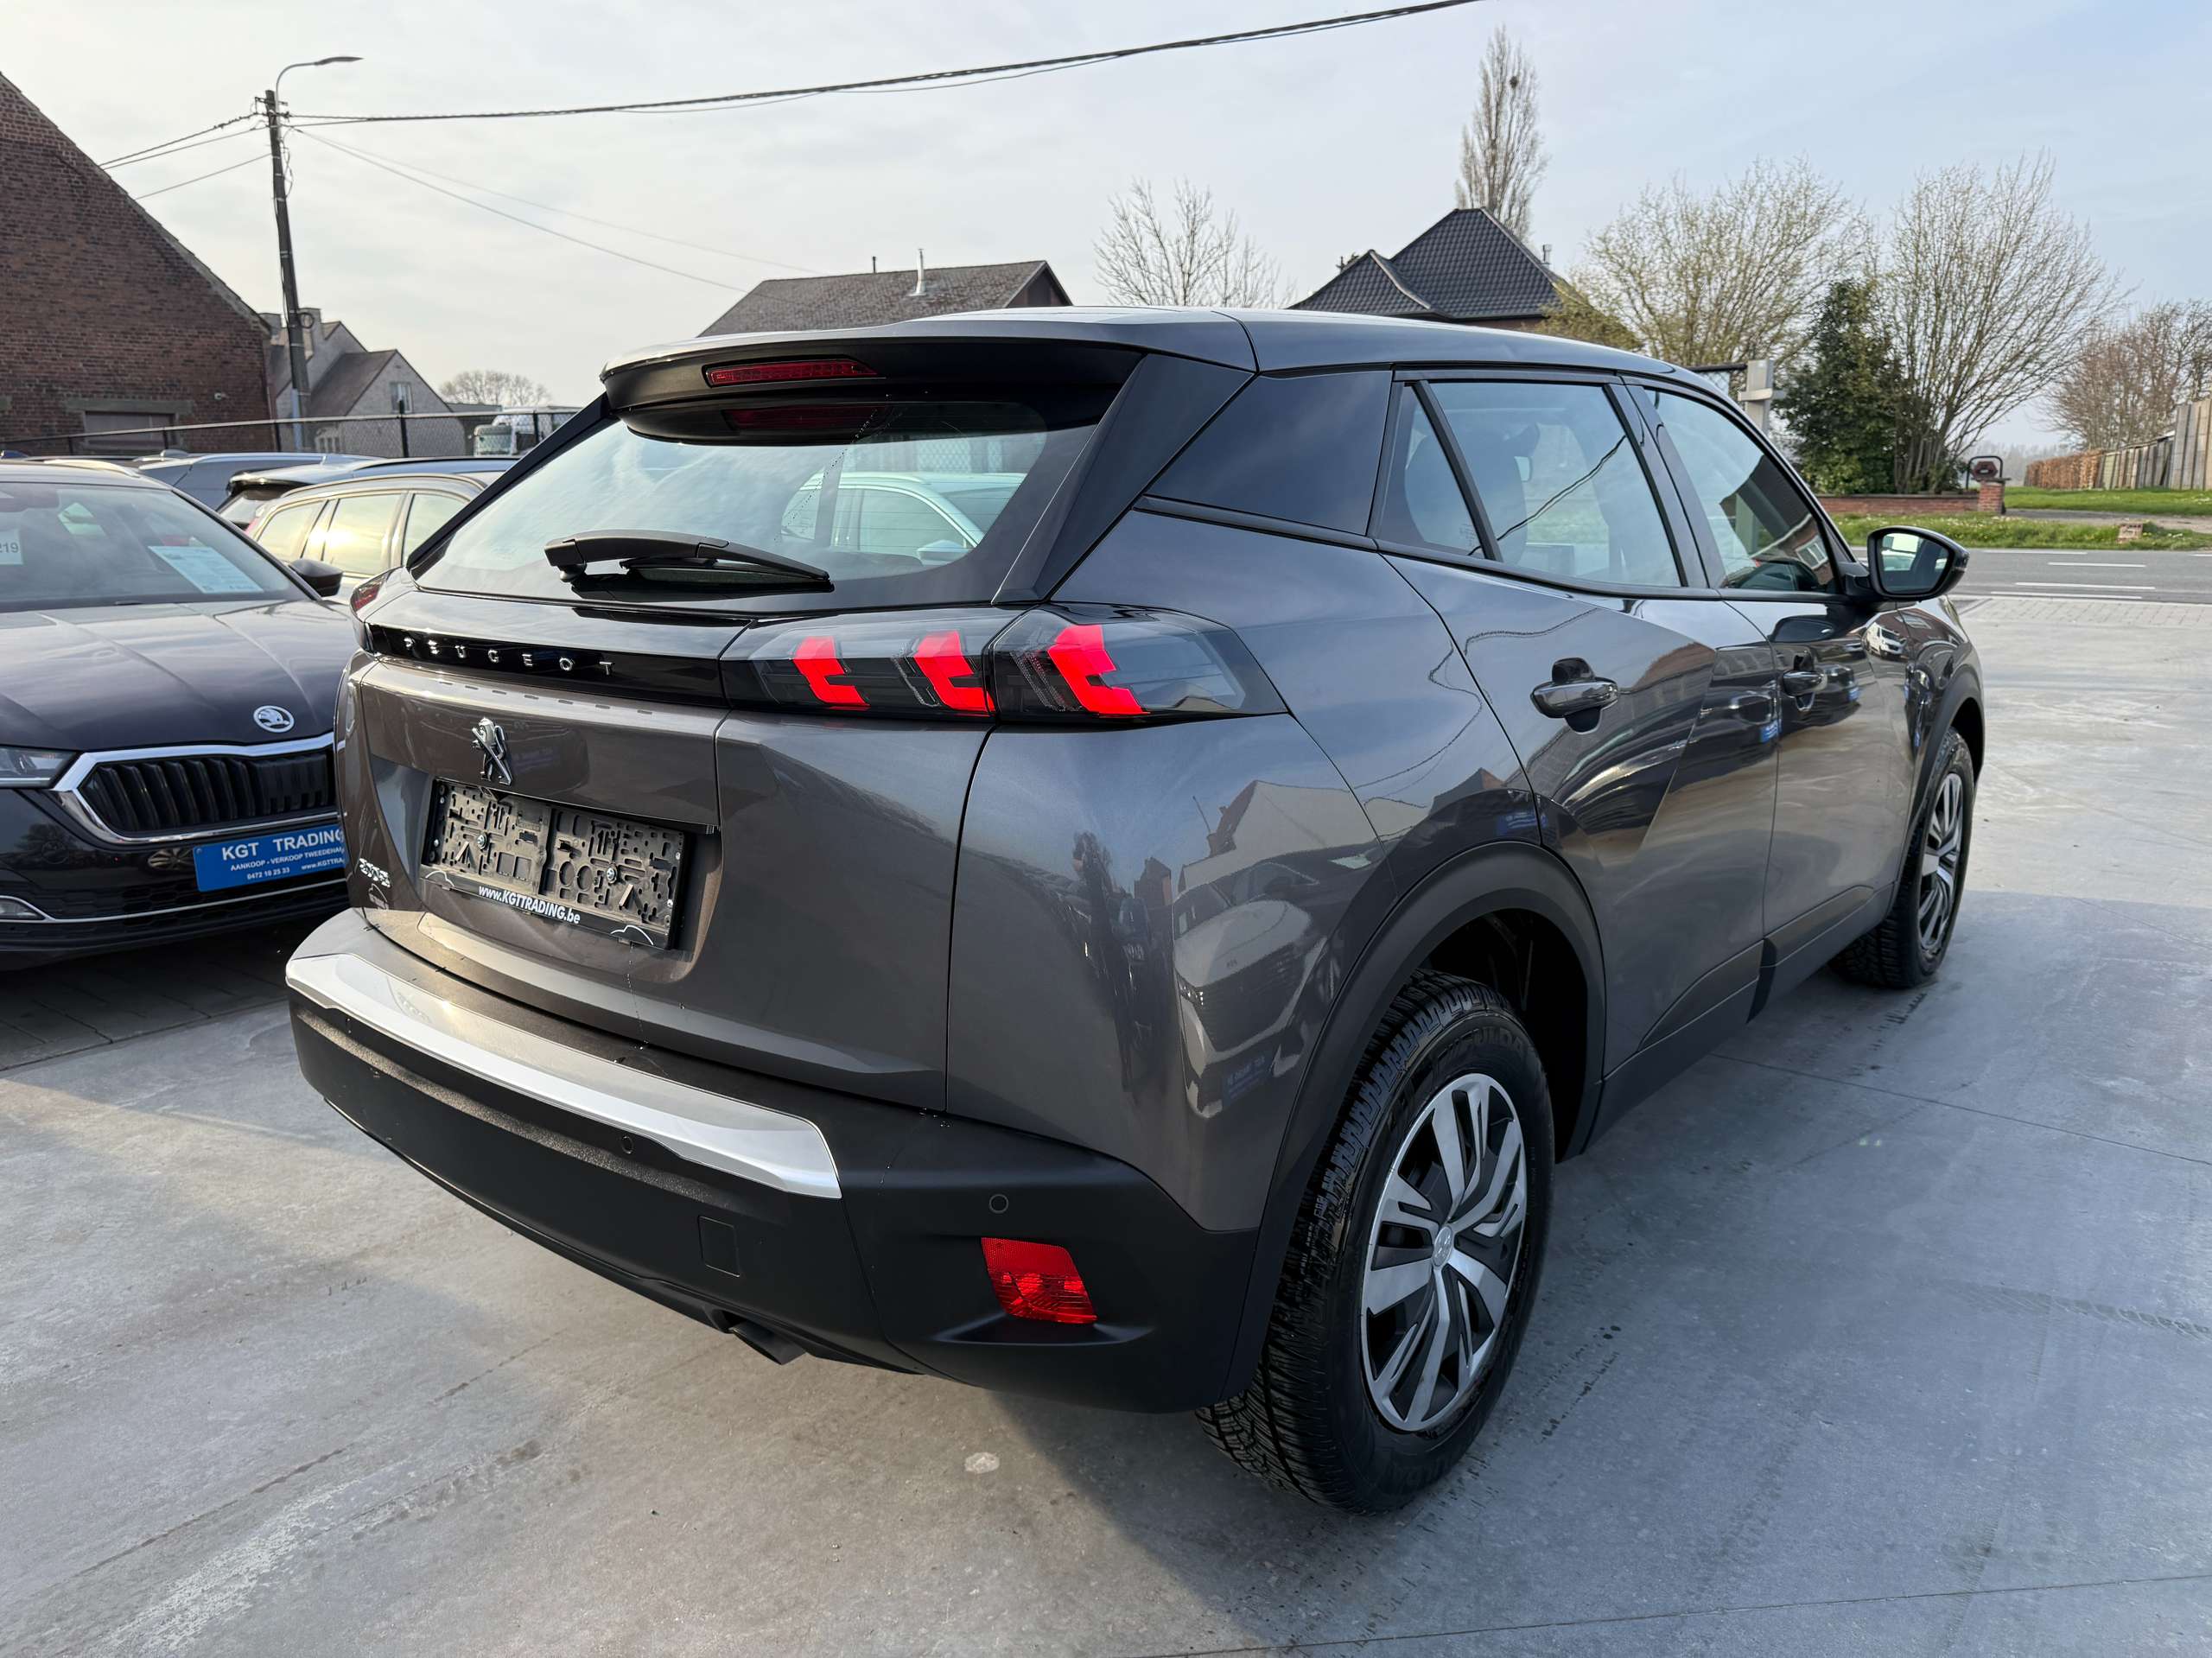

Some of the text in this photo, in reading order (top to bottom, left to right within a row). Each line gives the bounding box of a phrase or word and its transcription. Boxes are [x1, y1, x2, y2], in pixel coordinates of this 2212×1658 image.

[0, 542, 19, 554] 19
[403, 637, 615, 676] PEUGEOT
[221, 842, 259, 861] KGT
[230, 859, 266, 872] AANKOOP
[270, 854, 304, 866] VERKOOP
[246, 871, 263, 880] 0472
[301, 857, 345, 870] www.KGTTRA
[478, 886, 581, 924] www.KGTTRADING.be
